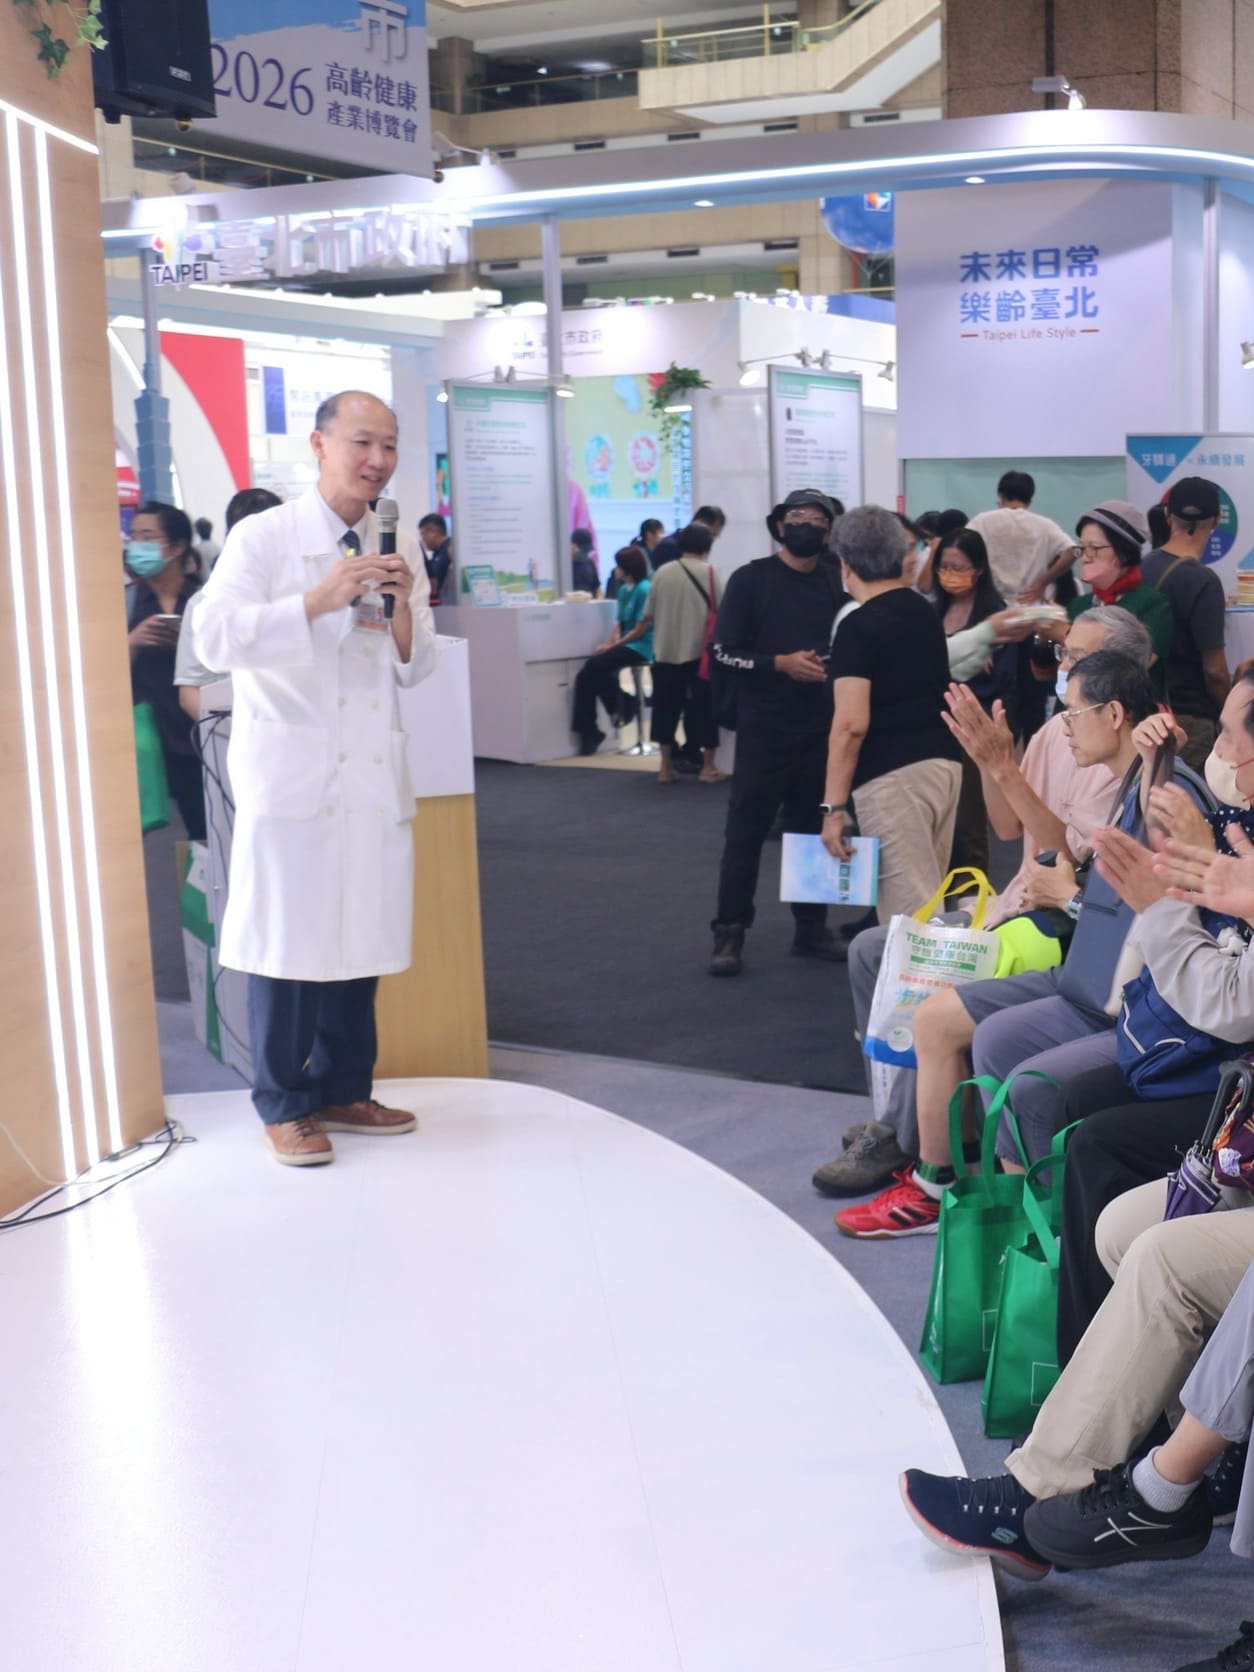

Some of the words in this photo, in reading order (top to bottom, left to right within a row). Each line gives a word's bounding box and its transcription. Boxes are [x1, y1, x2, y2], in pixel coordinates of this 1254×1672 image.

[210, 43, 315, 116] 2026
[325, 62, 418, 112] 高齡健康
[327, 101, 418, 143] 產業博覽會
[152, 263, 208, 283] TAIPEI
[960, 245, 1100, 283] 未來日常
[960, 286, 1099, 323] 樂齡臺北
[983, 330, 1017, 342] Taipei
[1020, 328, 1043, 340] Life
[1047, 326, 1077, 341] Style
[906, 932, 937, 948] TEAM
[943, 939, 988, 956] TAIWAN
